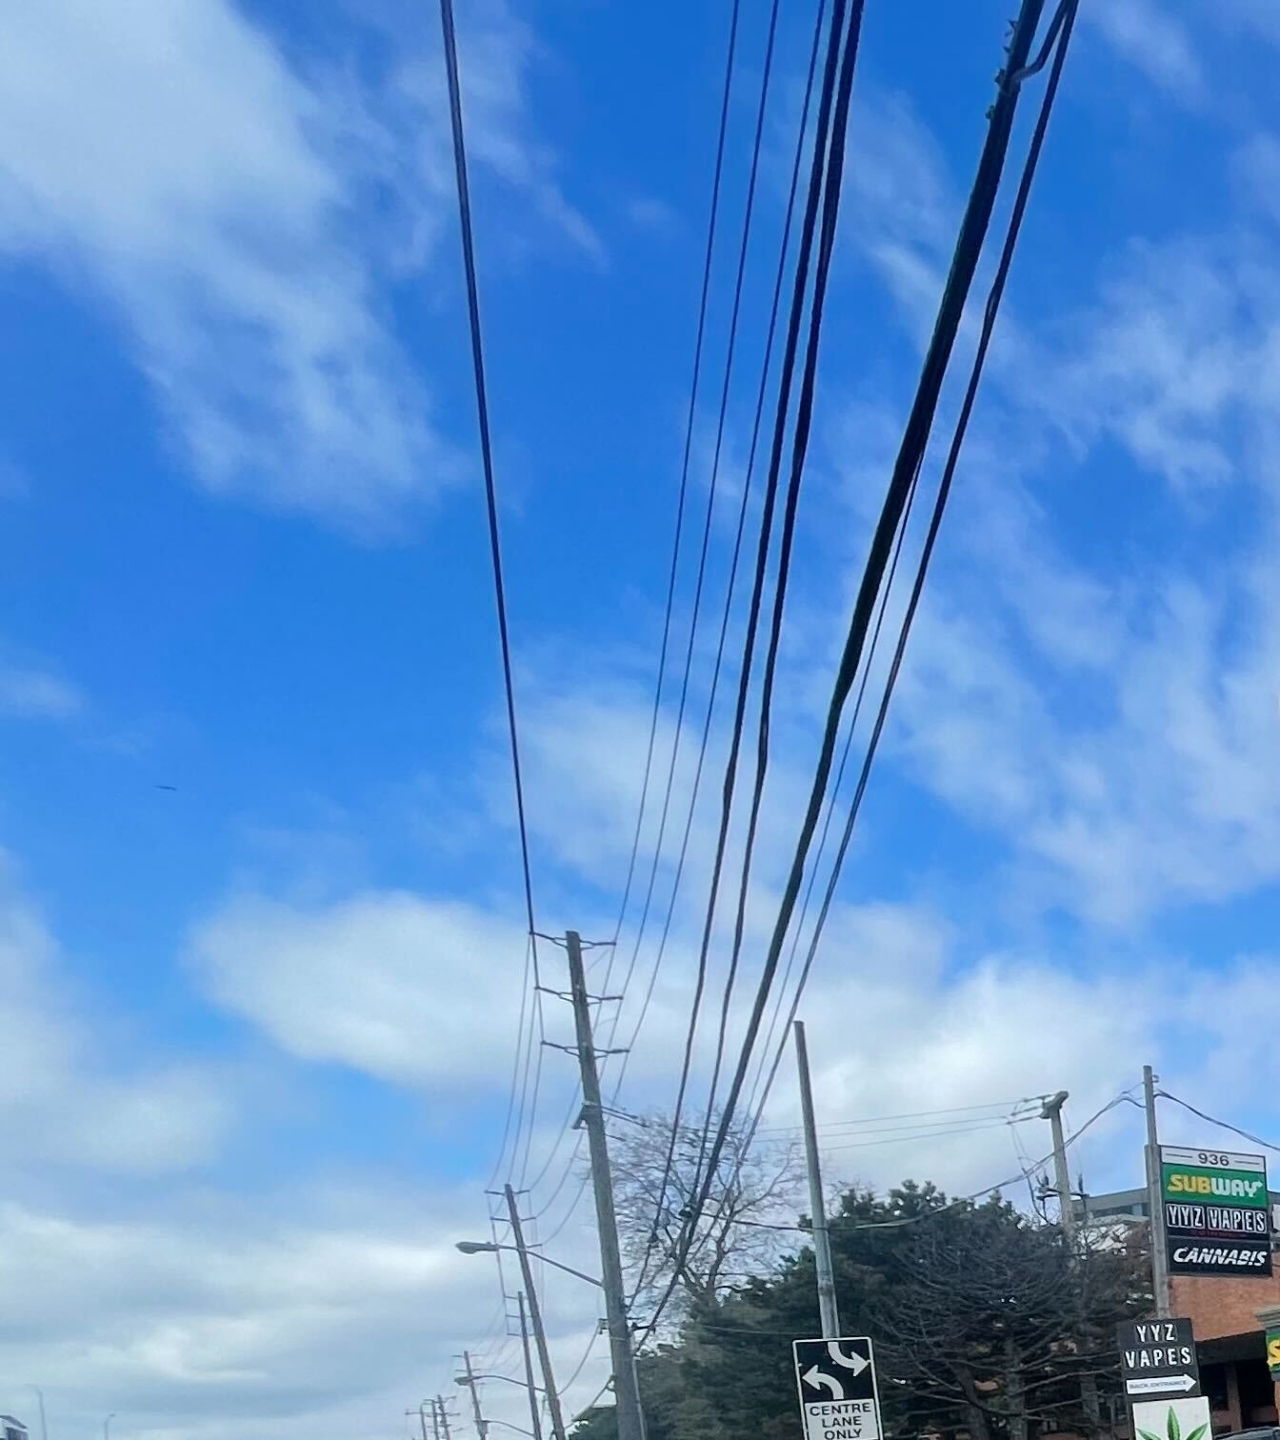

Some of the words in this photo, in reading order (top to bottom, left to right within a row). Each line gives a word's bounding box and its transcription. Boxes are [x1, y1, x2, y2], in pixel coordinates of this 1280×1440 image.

[1198, 1153, 1230, 1166] 936
[1167, 1174, 1263, 1197] SUBWAY
[1168, 1205, 1203, 1227] YYZ
[1208, 1208, 1267, 1232] VAPES
[1136, 1323, 1175, 1343] YYZ
[1125, 1347, 1191, 1368] VAPES
[809, 1402, 872, 1417] CENTRE
[821, 1415, 862, 1428] LANE
[824, 1428, 862, 1440] ONLY
